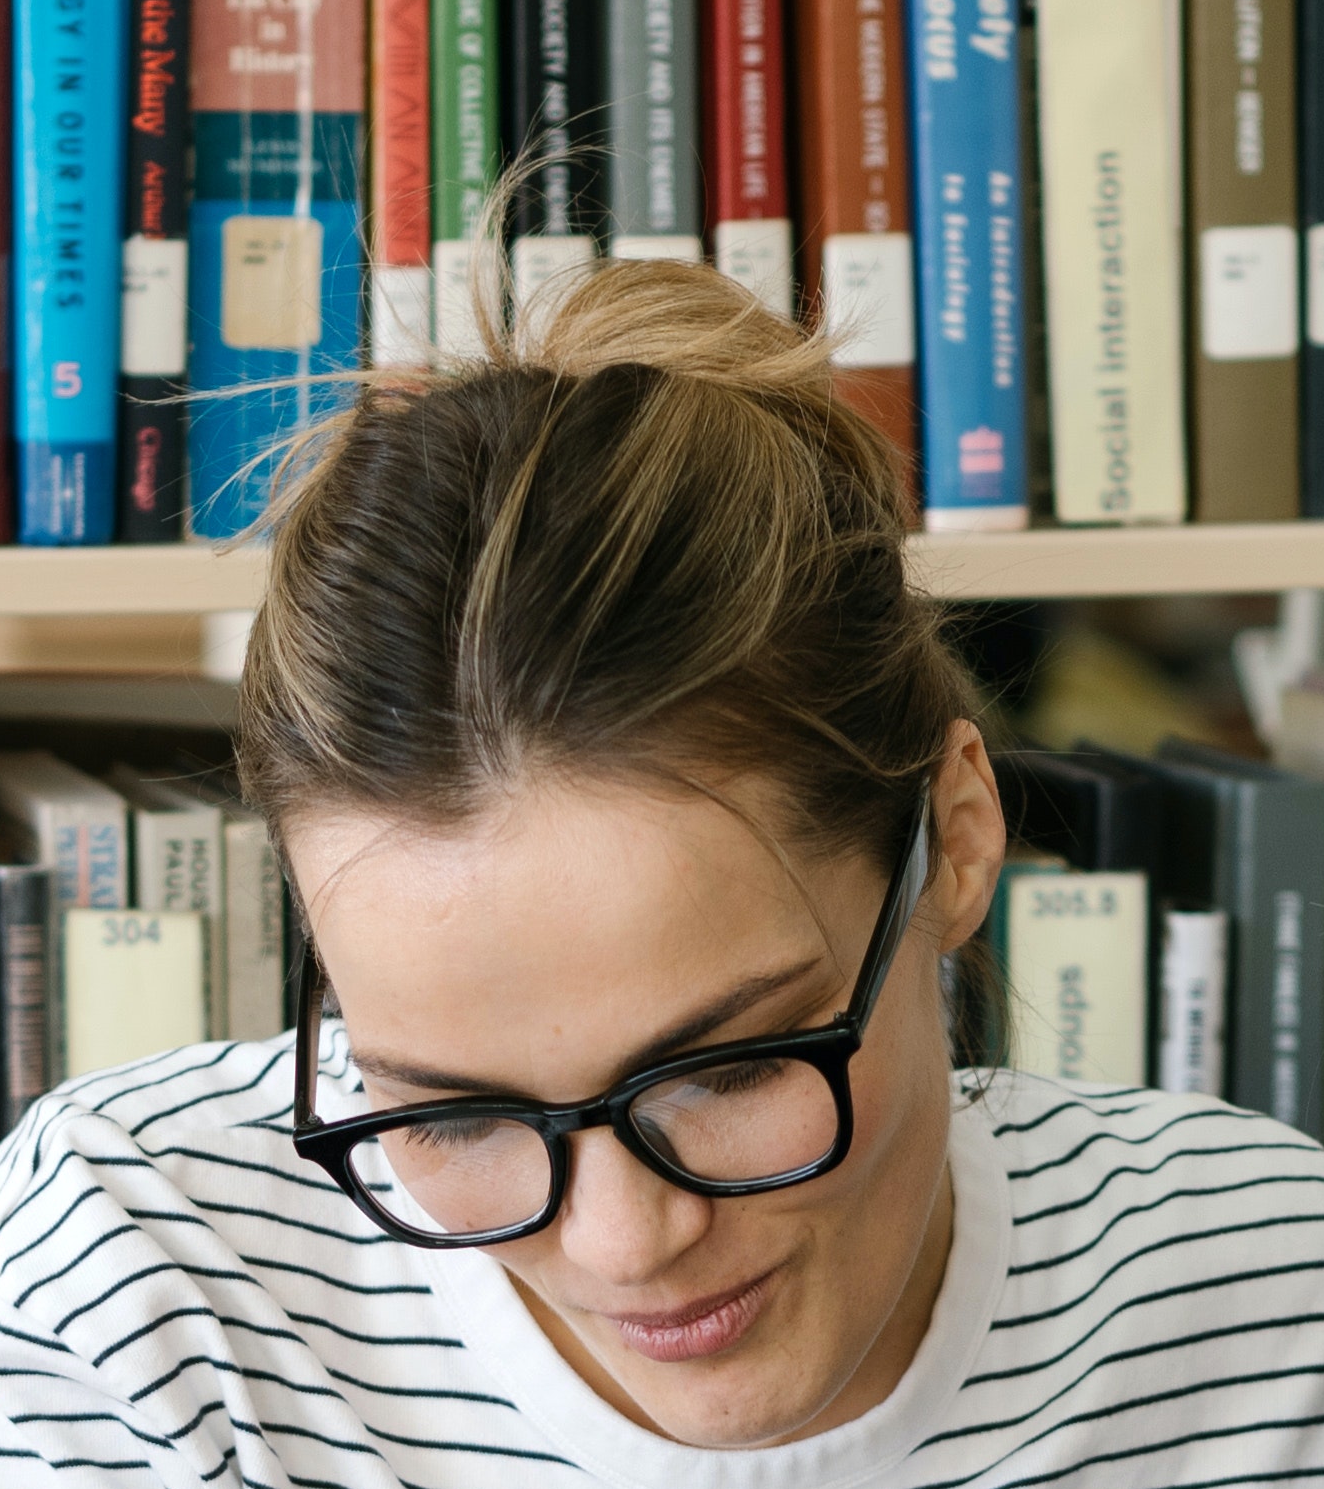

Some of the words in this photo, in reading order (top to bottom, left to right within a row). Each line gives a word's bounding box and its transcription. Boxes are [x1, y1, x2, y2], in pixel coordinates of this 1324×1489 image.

[53, 55, 88, 93] IN
[132, 49, 176, 139] Many
[53, 110, 88, 182] OUR
[53, 199, 88, 310] TIMES
[1088, 150, 1125, 373] interaction
[1094, 388, 1130, 514] Social
[102, 918, 162, 945] 304
[1055, 964, 1090, 1079] roups
